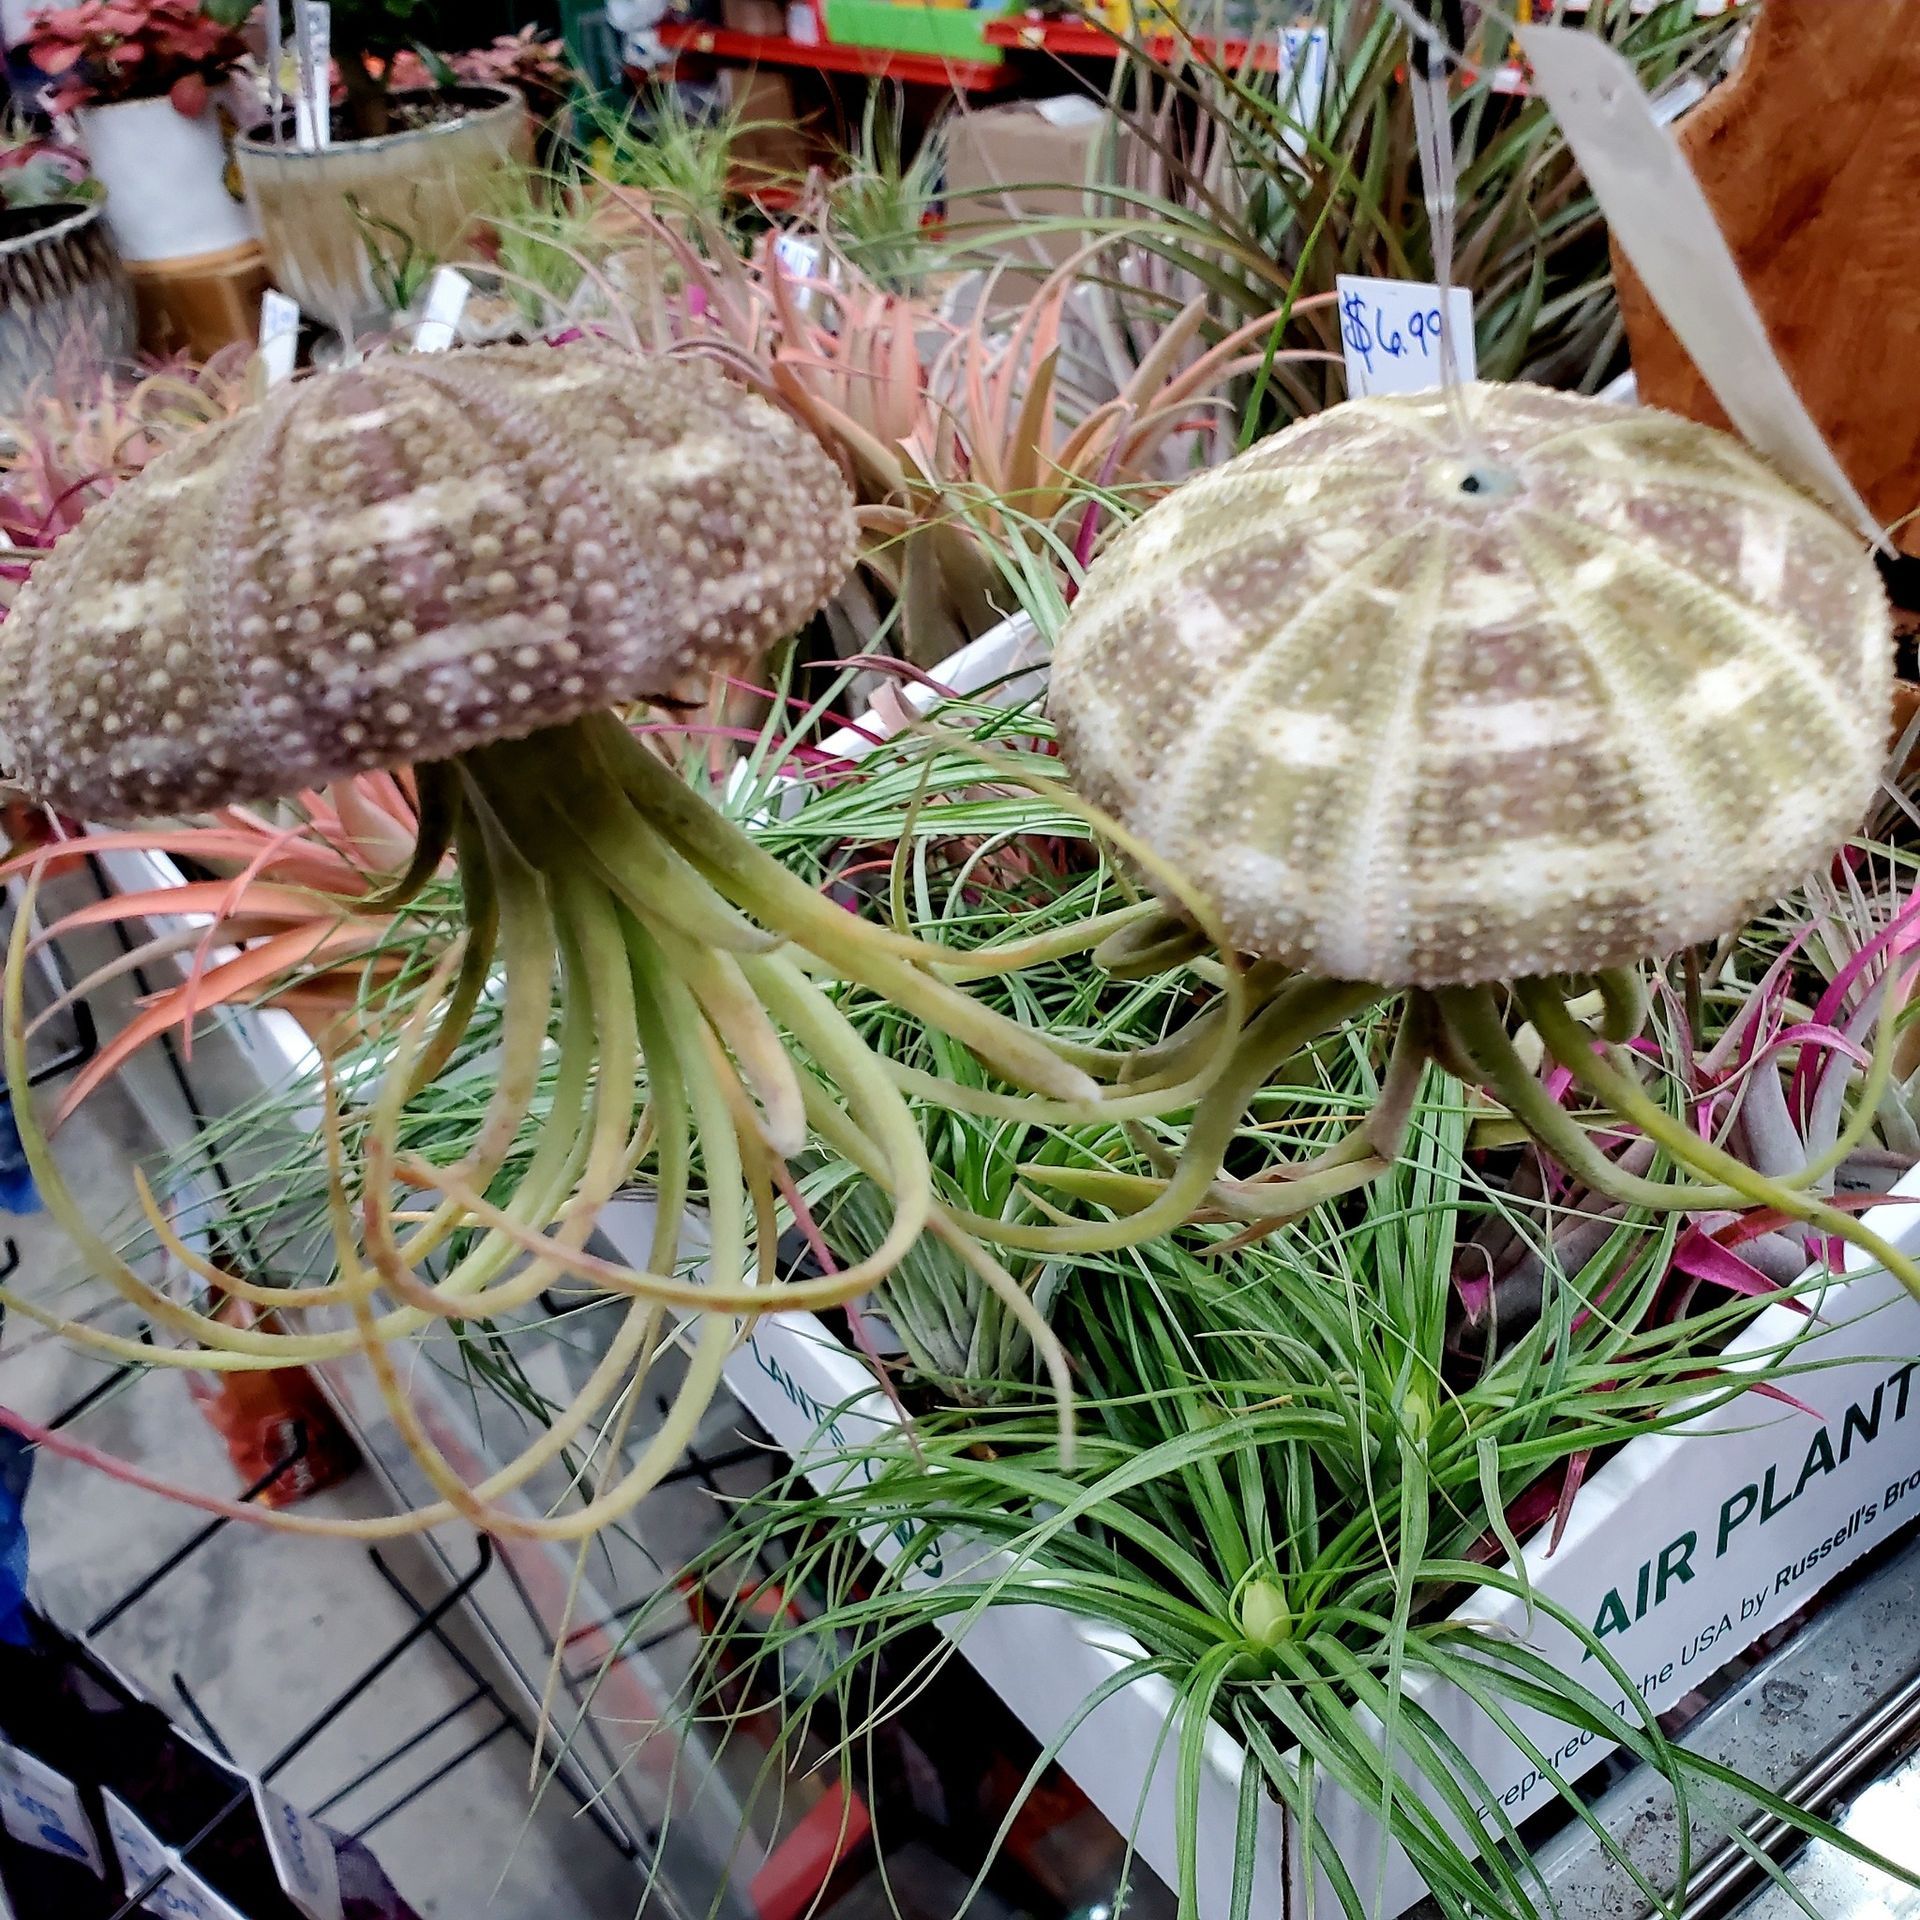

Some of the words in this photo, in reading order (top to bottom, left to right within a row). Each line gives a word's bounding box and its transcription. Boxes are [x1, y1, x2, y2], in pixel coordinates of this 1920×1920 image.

[1580, 1529, 1698, 1664] AIR
[1681, 1613, 1732, 1666] USA
[1740, 1586, 1769, 1622] by
[1774, 1502, 1878, 1596] Russell's
